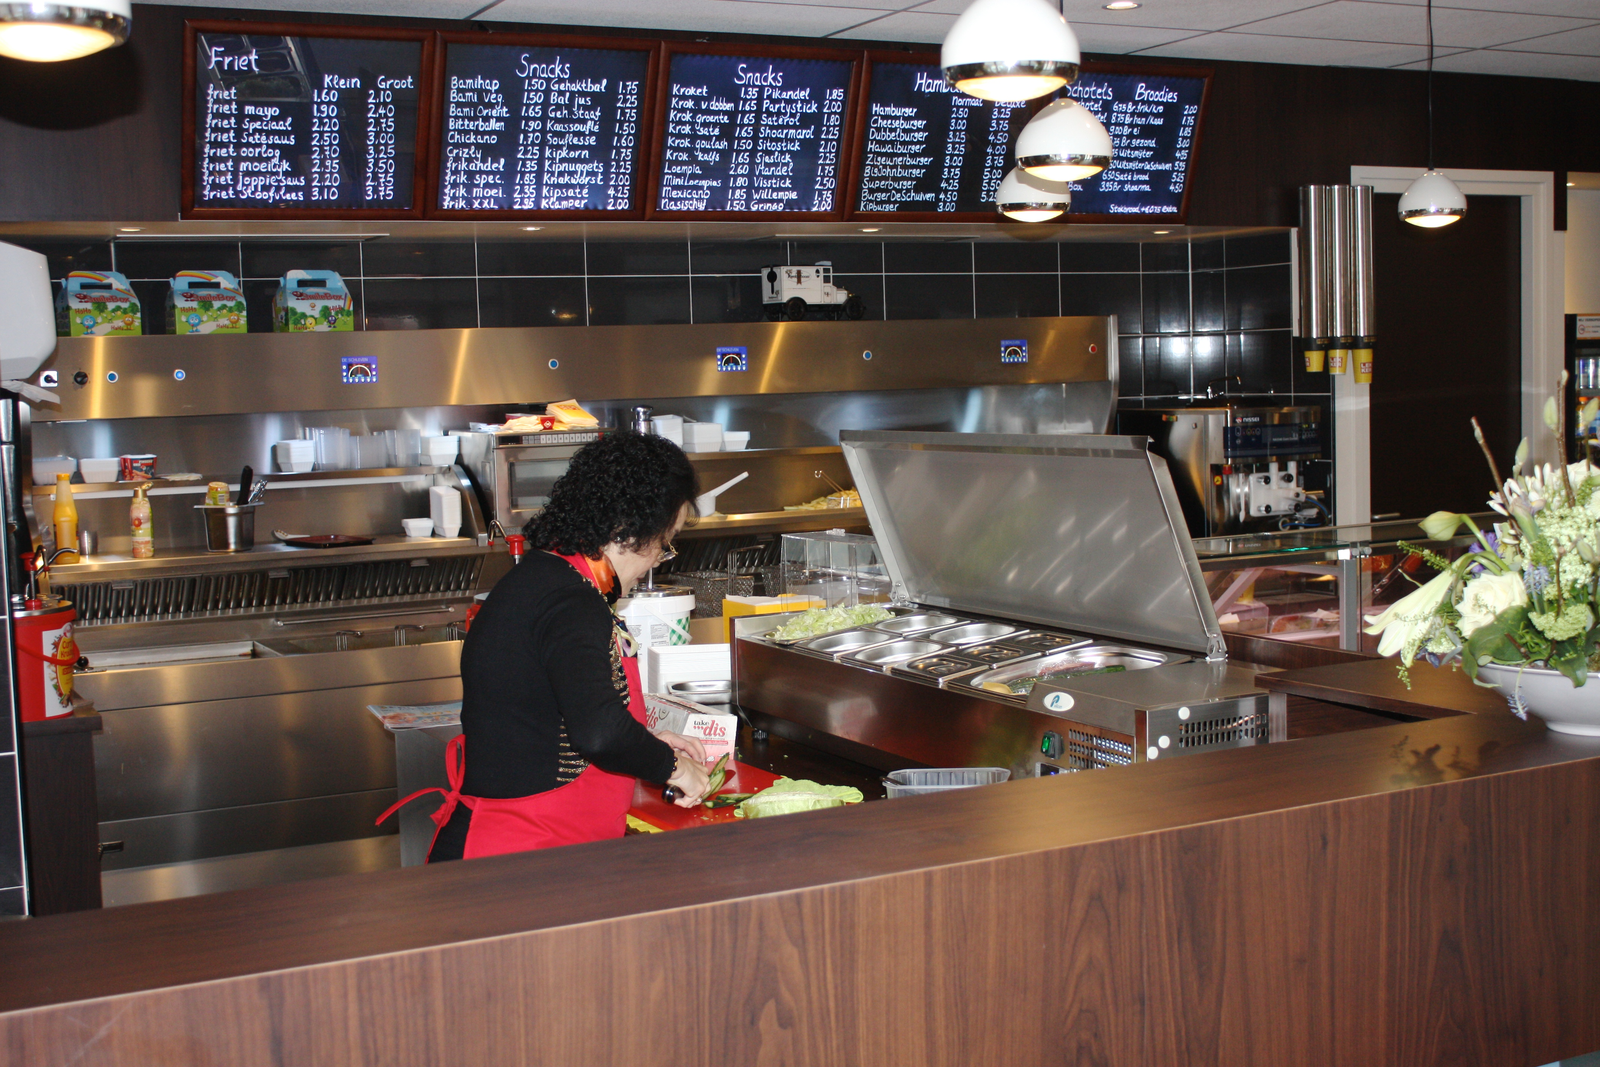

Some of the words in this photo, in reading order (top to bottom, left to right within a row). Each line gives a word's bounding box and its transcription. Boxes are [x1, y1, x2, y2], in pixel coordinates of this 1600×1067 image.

[208, 47, 259, 72] Friet
[516, 54, 570, 78] Snacks
[324, 74, 360, 88] Klein
[378, 76, 413, 88] Groot
[734, 64, 783, 86] Snacks
[451, 75, 499, 92] Bamihap
[525, 79, 546, 90] 1.50
[550, 79, 607, 93] Gehaktbal
[619, 82, 638, 93] 1.75
[673, 84, 707, 96] Kroket
[450, 90, 477, 102] Bami
[764, 87, 809, 99] Pikandel
[550, 93, 569, 104] Bal
[574, 94, 591, 111] jus
[671, 98, 697, 108] Krok.
[762, 100, 817, 117] Partystick
[245, 106, 279, 120] mayo
[450, 104, 473, 116] Bami
[522, 106, 541, 117] 1.65
[617, 109, 636, 120] 1.75
[873, 103, 917, 117] Hamburger
[992, 109, 1011, 118] 3.25
[449, 118, 504, 131] Bitterballen
[522, 120, 541, 131] 1.90
[547, 119, 599, 134] Kaassouflé
[615, 123, 635, 134] 1.50
[669, 123, 694, 134] Krok.
[697, 125, 719, 135] saté
[871, 116, 926, 130] Cheeseburger
[950, 120, 966, 129] 3.00
[990, 120, 1008, 130] 3.75
[448, 132, 497, 143] Chickano
[520, 133, 541, 144] 1.70
[759, 126, 814, 138] Shoarmarol
[869, 128, 928, 142] Dubbelburger
[947, 132, 965, 142] 3.25
[989, 133, 1008, 143] 4.50
[614, 135, 634, 146] 1.60
[668, 136, 693, 147] Krok.
[695, 138, 727, 155] goulash
[757, 139, 800, 151] Sitostick
[612, 149, 632, 160] 1.75
[868, 141, 926, 153] Hawaiburger
[987, 145, 1006, 155] 4.00
[241, 146, 280, 164] oorlog
[666, 149, 691, 160] Krok.
[697, 152, 719, 165] kalfs
[755, 152, 792, 166] Sjaslick
[866, 154, 933, 165] Zigeunerburger
[944, 156, 962, 166] 3.00
[517, 161, 537, 171] 1.35
[544, 160, 603, 177] Kipnuggets
[664, 164, 702, 177] Loempia
[755, 163, 793, 175] Viandel
[818, 166, 834, 176] 1.75
[474, 174, 504, 186] spec.
[516, 173, 536, 184] 1.85
[543, 173, 603, 184] Knakworst
[942, 168, 960, 178] 3.75
[983, 168, 1002, 179] 5.00
[754, 177, 792, 187] Visstick
[862, 178, 916, 191] Superburger
[941, 180, 958, 189] 4.25
[473, 187, 506, 197] moei.
[542, 186, 589, 200] Kipsaté
[607, 186, 629, 198] 4.25
[662, 187, 710, 199] Mexicano
[728, 189, 746, 199] 1.85
[752, 189, 798, 204] Willempie
[815, 191, 832, 200] 1.75
[860, 201, 899, 211] Kipburger
[938, 202, 955, 211] 3.00
